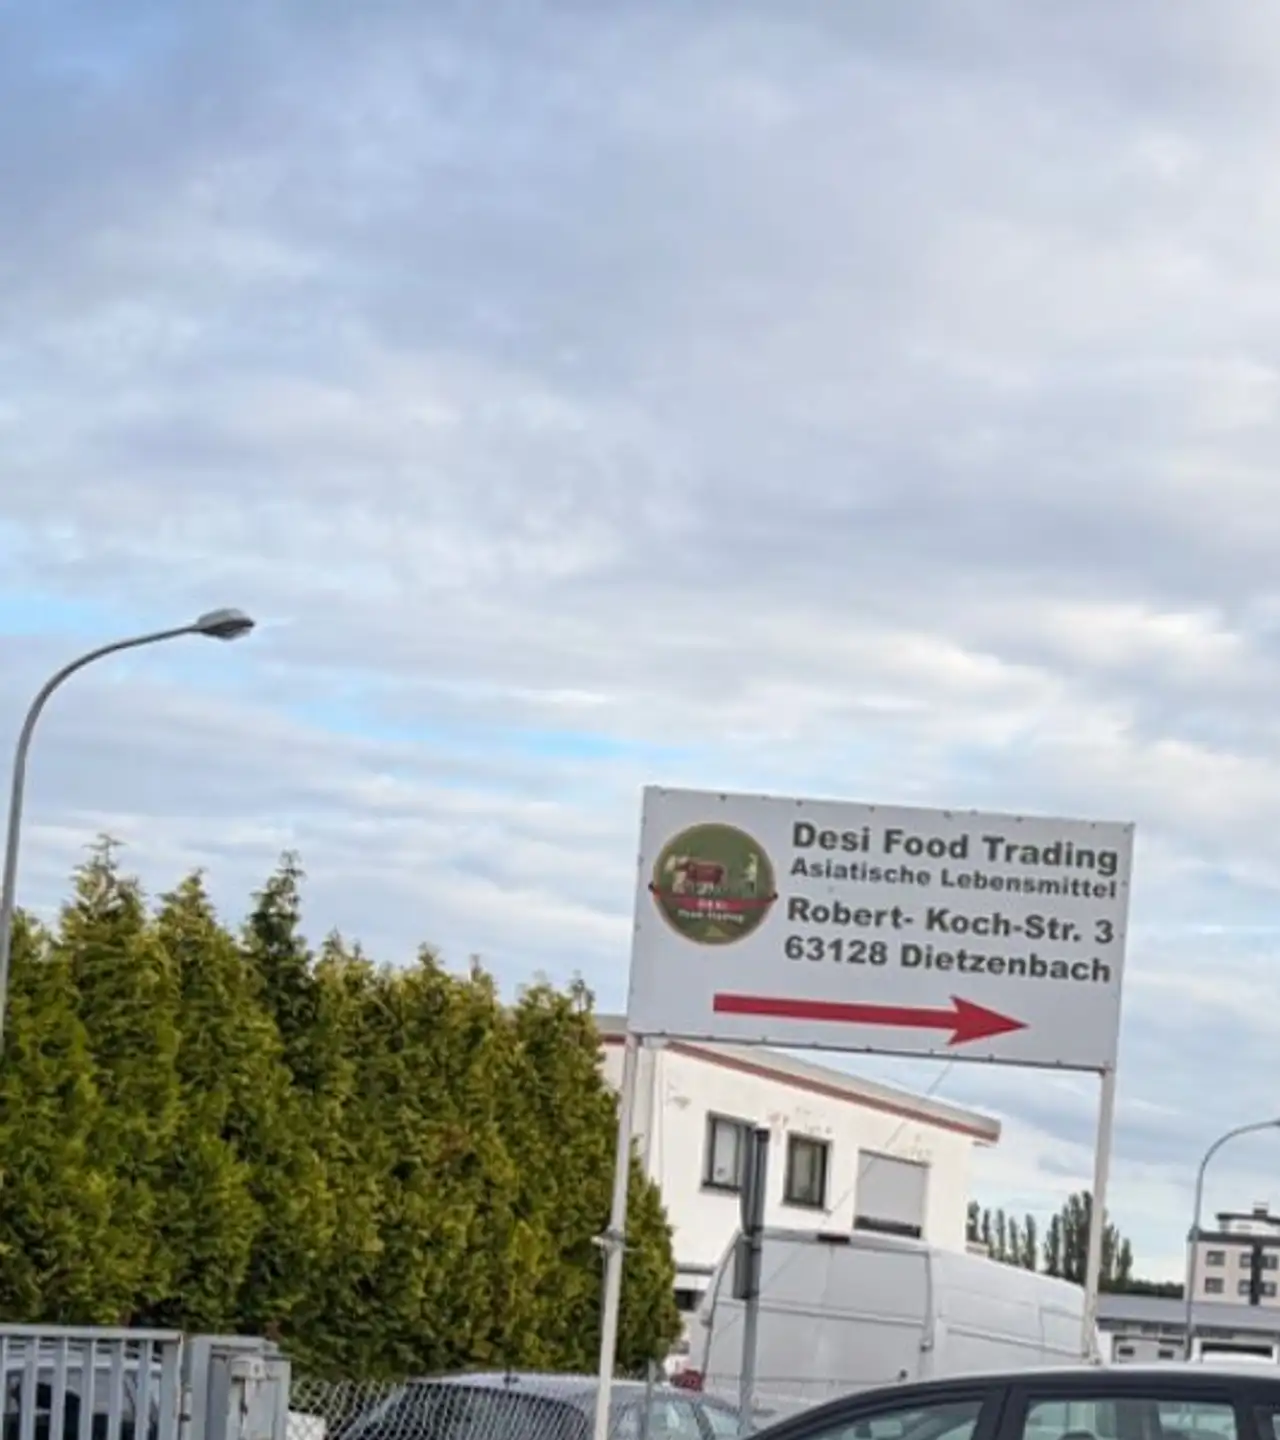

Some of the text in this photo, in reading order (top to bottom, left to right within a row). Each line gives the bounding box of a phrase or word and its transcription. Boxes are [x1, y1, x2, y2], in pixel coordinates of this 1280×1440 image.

[792, 821, 1118, 877] Desi Food Trading
[790, 856, 1117, 898] Asiatische Lebensmittel
[787, 897, 1114, 945] Robert- Koch-Str. 3
[784, 934, 1111, 983] 63128 Dietzenbach
